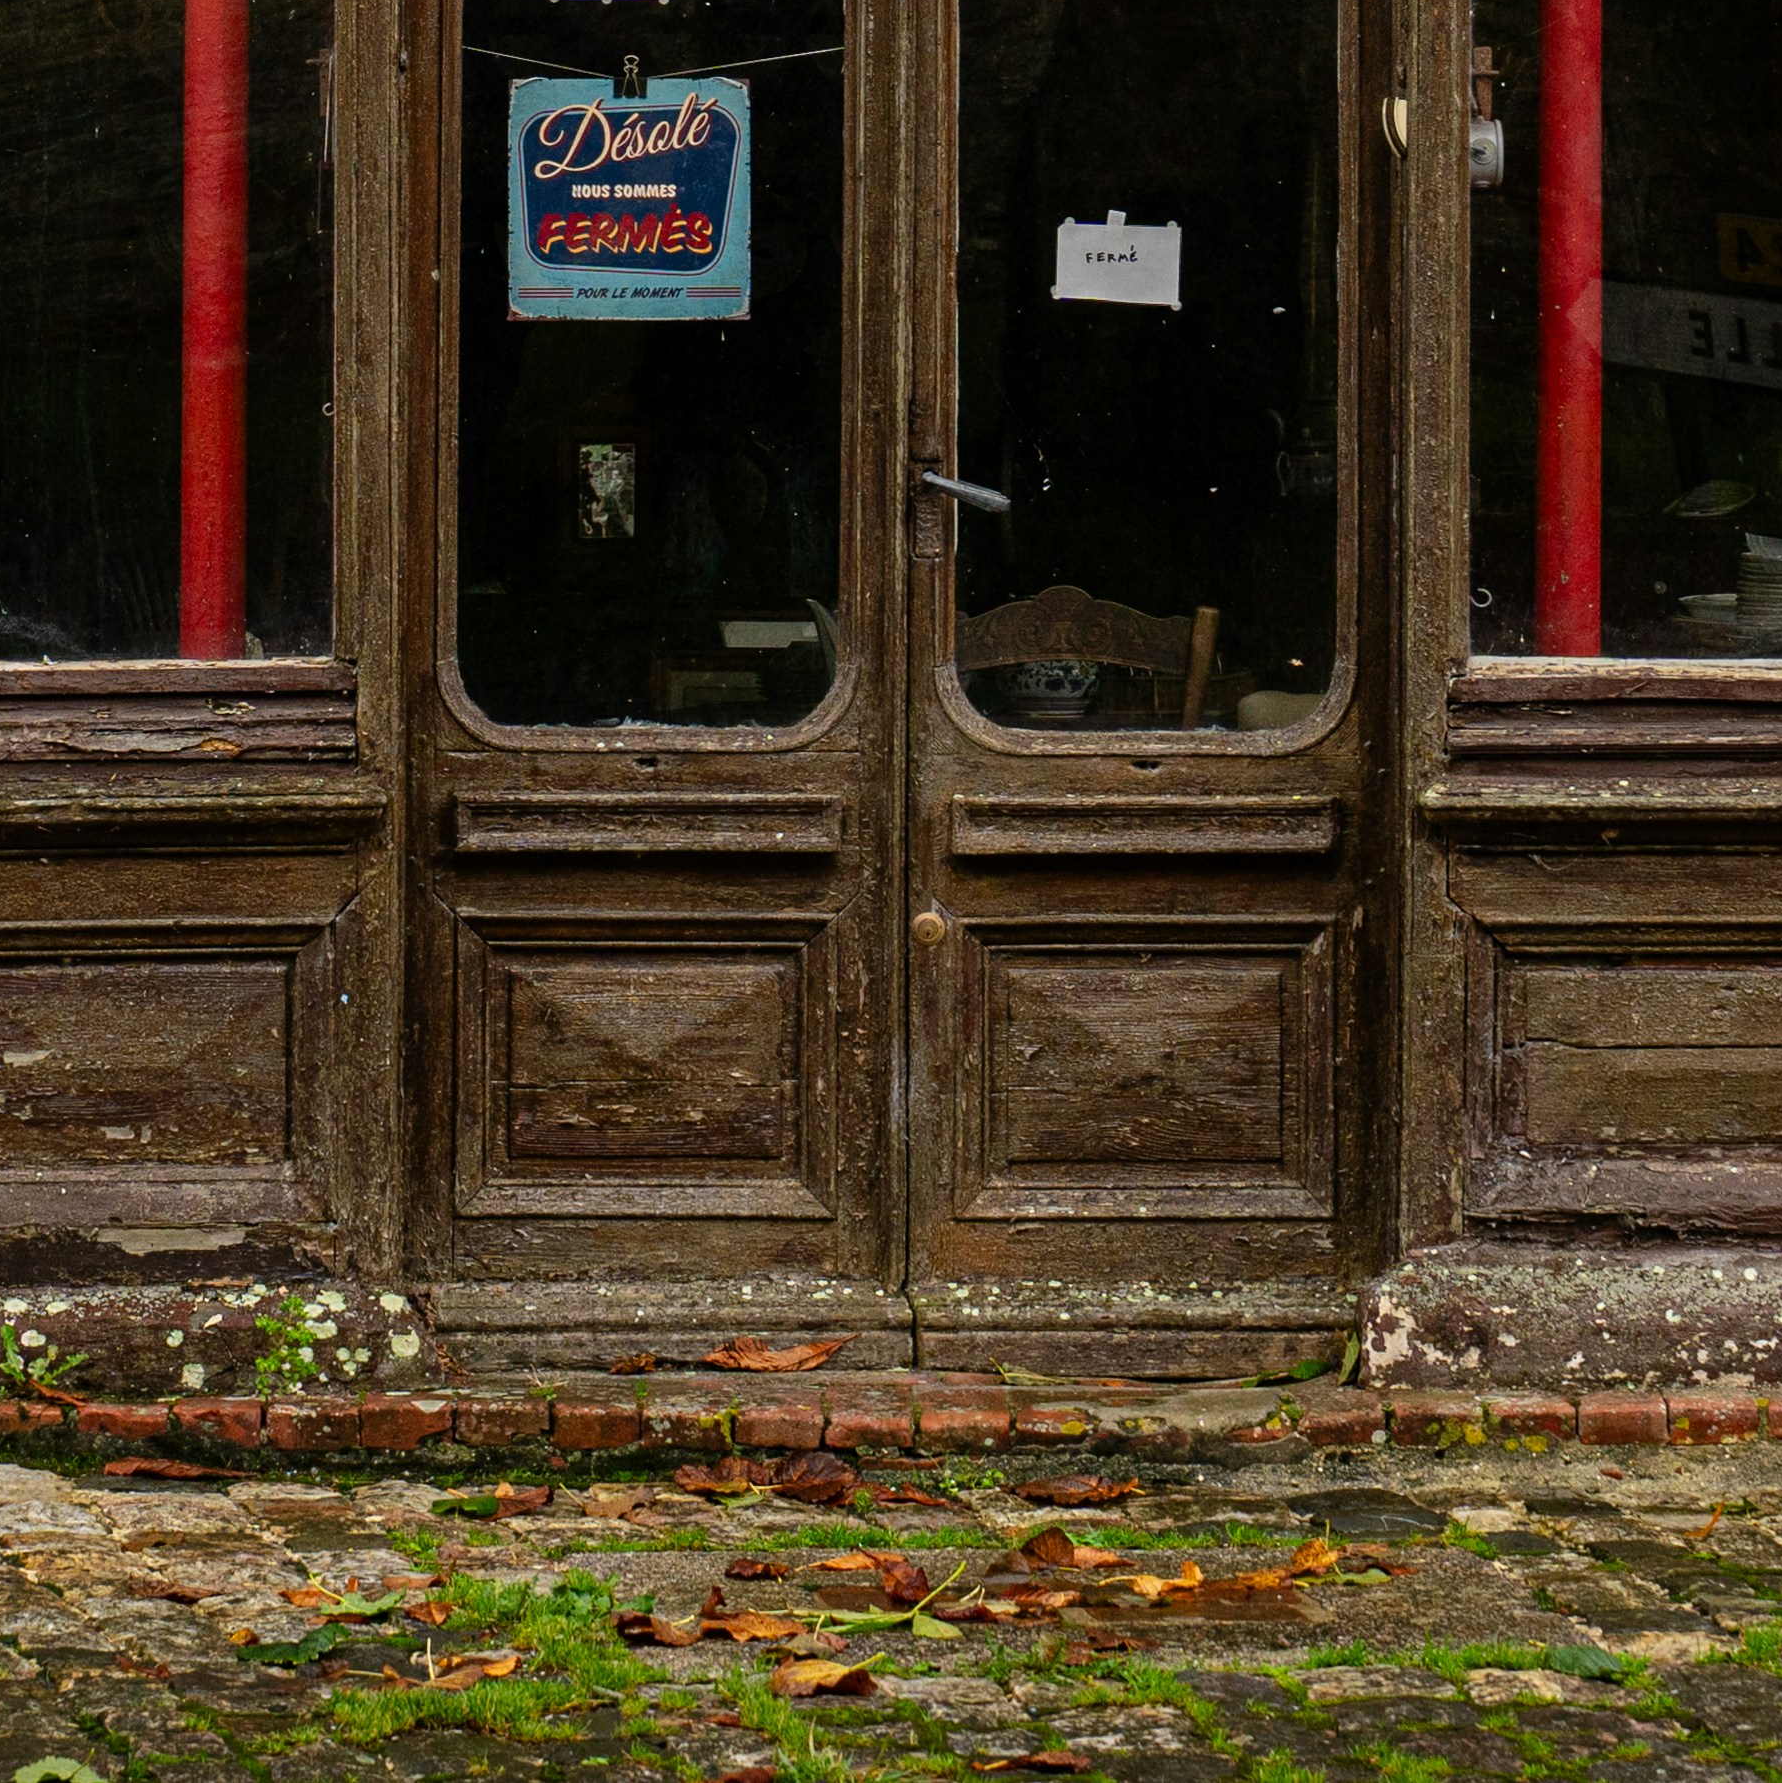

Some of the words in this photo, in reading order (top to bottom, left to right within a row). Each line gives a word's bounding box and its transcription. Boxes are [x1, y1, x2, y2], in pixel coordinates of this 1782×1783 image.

[534, 92, 718, 179] Désolé
[572, 184, 611, 198] NOUS
[613, 184, 677, 198] SOMMES
[537, 203, 713, 254] FERMÉS
[1085, 244, 1139, 264] FERMÉ
[576, 287, 608, 299] POUR
[612, 287, 627, 299] LE
[631, 287, 685, 299] MOMENT
